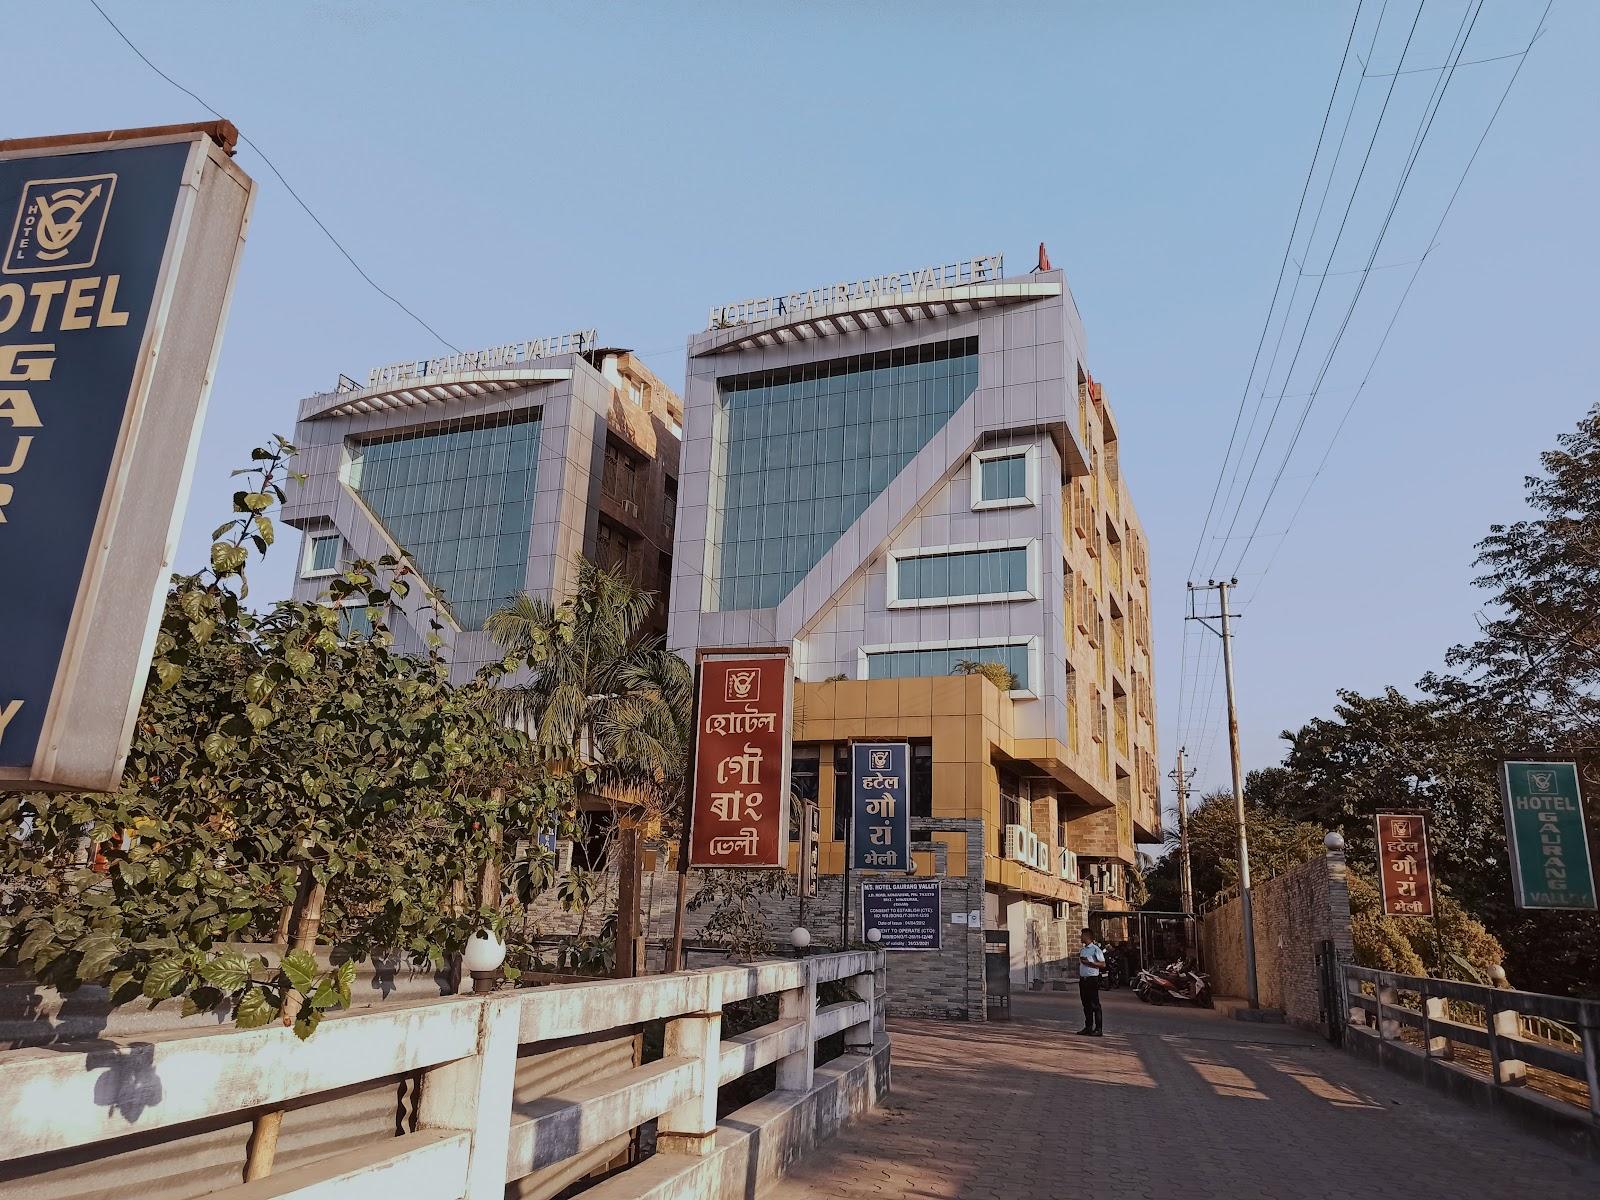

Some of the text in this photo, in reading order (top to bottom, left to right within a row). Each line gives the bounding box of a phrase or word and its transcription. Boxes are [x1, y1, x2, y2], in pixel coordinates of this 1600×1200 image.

[16, 205, 38, 260] HOTEL
[708, 250, 1003, 329] HOTEL GAURANG VALLEY
[367, 359, 421, 387] HOTEL
[524, 328, 597, 361] VALLEY
[705, 703, 777, 736] হোটেল
[717, 742, 764, 785] গৌ
[1516, 796, 1576, 811] HOTEL
[709, 827, 760, 856] ভেলী
[1538, 812, 1568, 890] GAURANG
